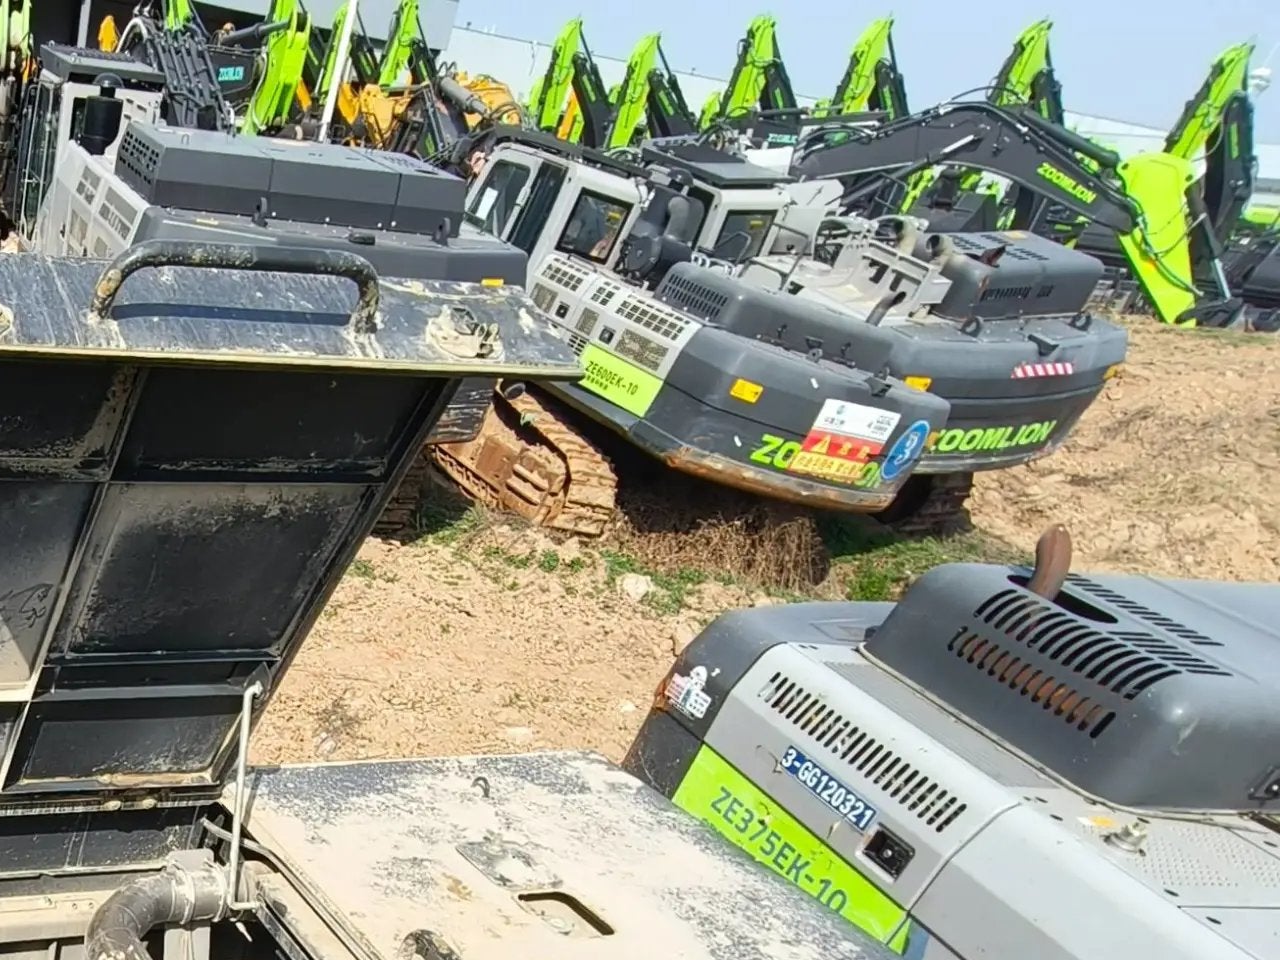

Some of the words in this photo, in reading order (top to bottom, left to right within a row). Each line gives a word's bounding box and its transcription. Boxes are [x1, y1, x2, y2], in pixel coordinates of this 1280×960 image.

[1036, 161, 1098, 204] ZOOMLION
[585, 360, 639, 395] ZE600EK-10
[929, 419, 1057, 452] OOMLION
[781, 748, 875, 830] 3-GG120321
[710, 786, 848, 914] ZE375EK-10
